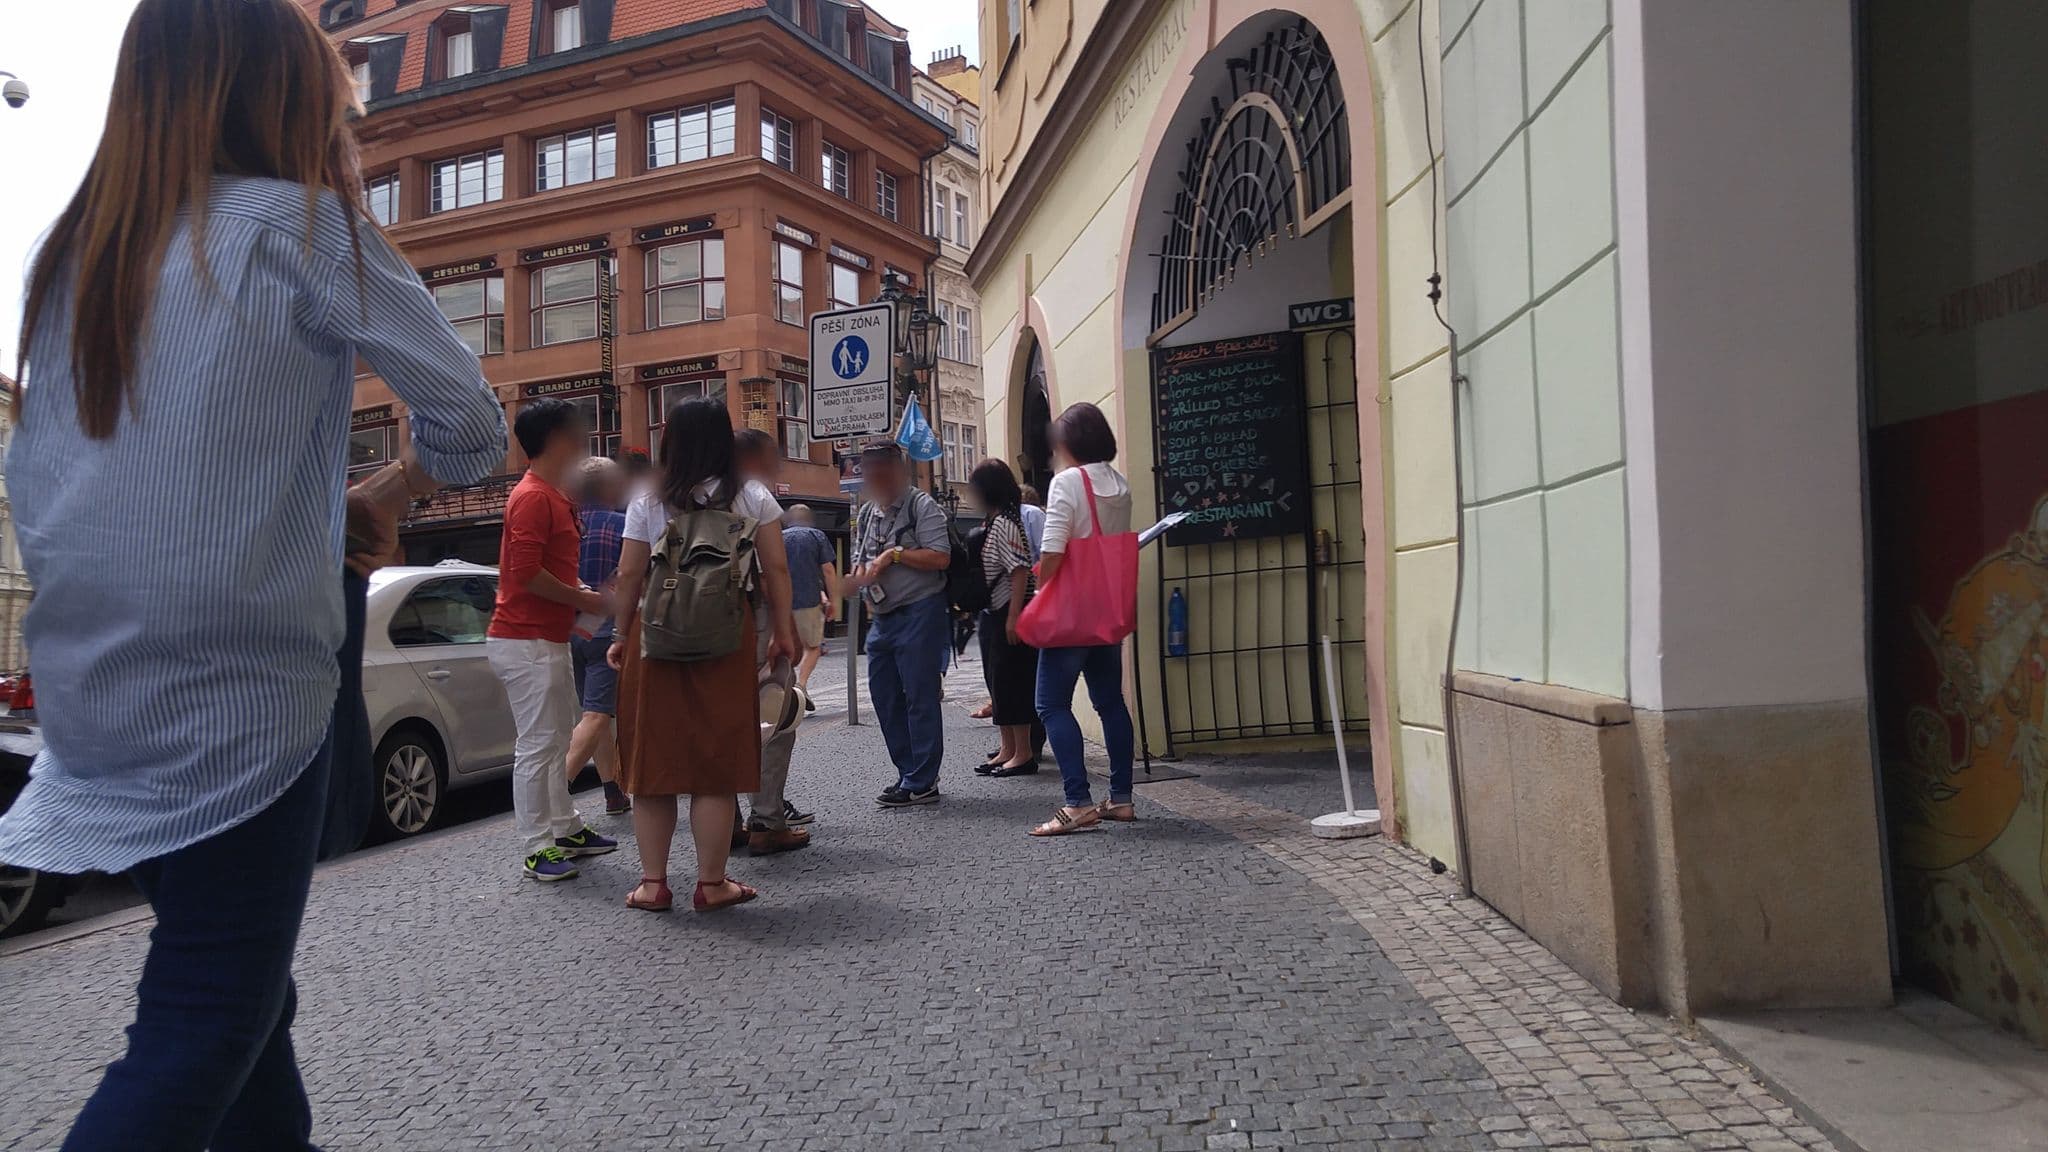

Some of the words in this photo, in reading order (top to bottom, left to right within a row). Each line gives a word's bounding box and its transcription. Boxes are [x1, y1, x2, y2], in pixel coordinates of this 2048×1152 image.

[1293, 302, 1343, 324] WC
[821, 317, 845, 334] PĚŠÍ
[851, 315, 880, 331] ZÓNA
[1168, 371, 1206, 388] PORK
[1209, 360, 1275, 379] KNUCKLE
[538, 381, 572, 394] GRAND
[853, 385, 884, 395] OBSLUHA
[842, 397, 855, 405] TAXI
[841, 415, 848, 423] SE
[849, 411, 885, 421] SOUHLASEM
[842, 422, 866, 431] PRAHA
[1168, 433, 1198, 449] SOUP
[1214, 429, 1257, 445] BREAD
[1168, 450, 1200, 465] BEEF
[1205, 443, 1257, 460] GULASH
[1185, 501, 1275, 524] RESTAURANT
